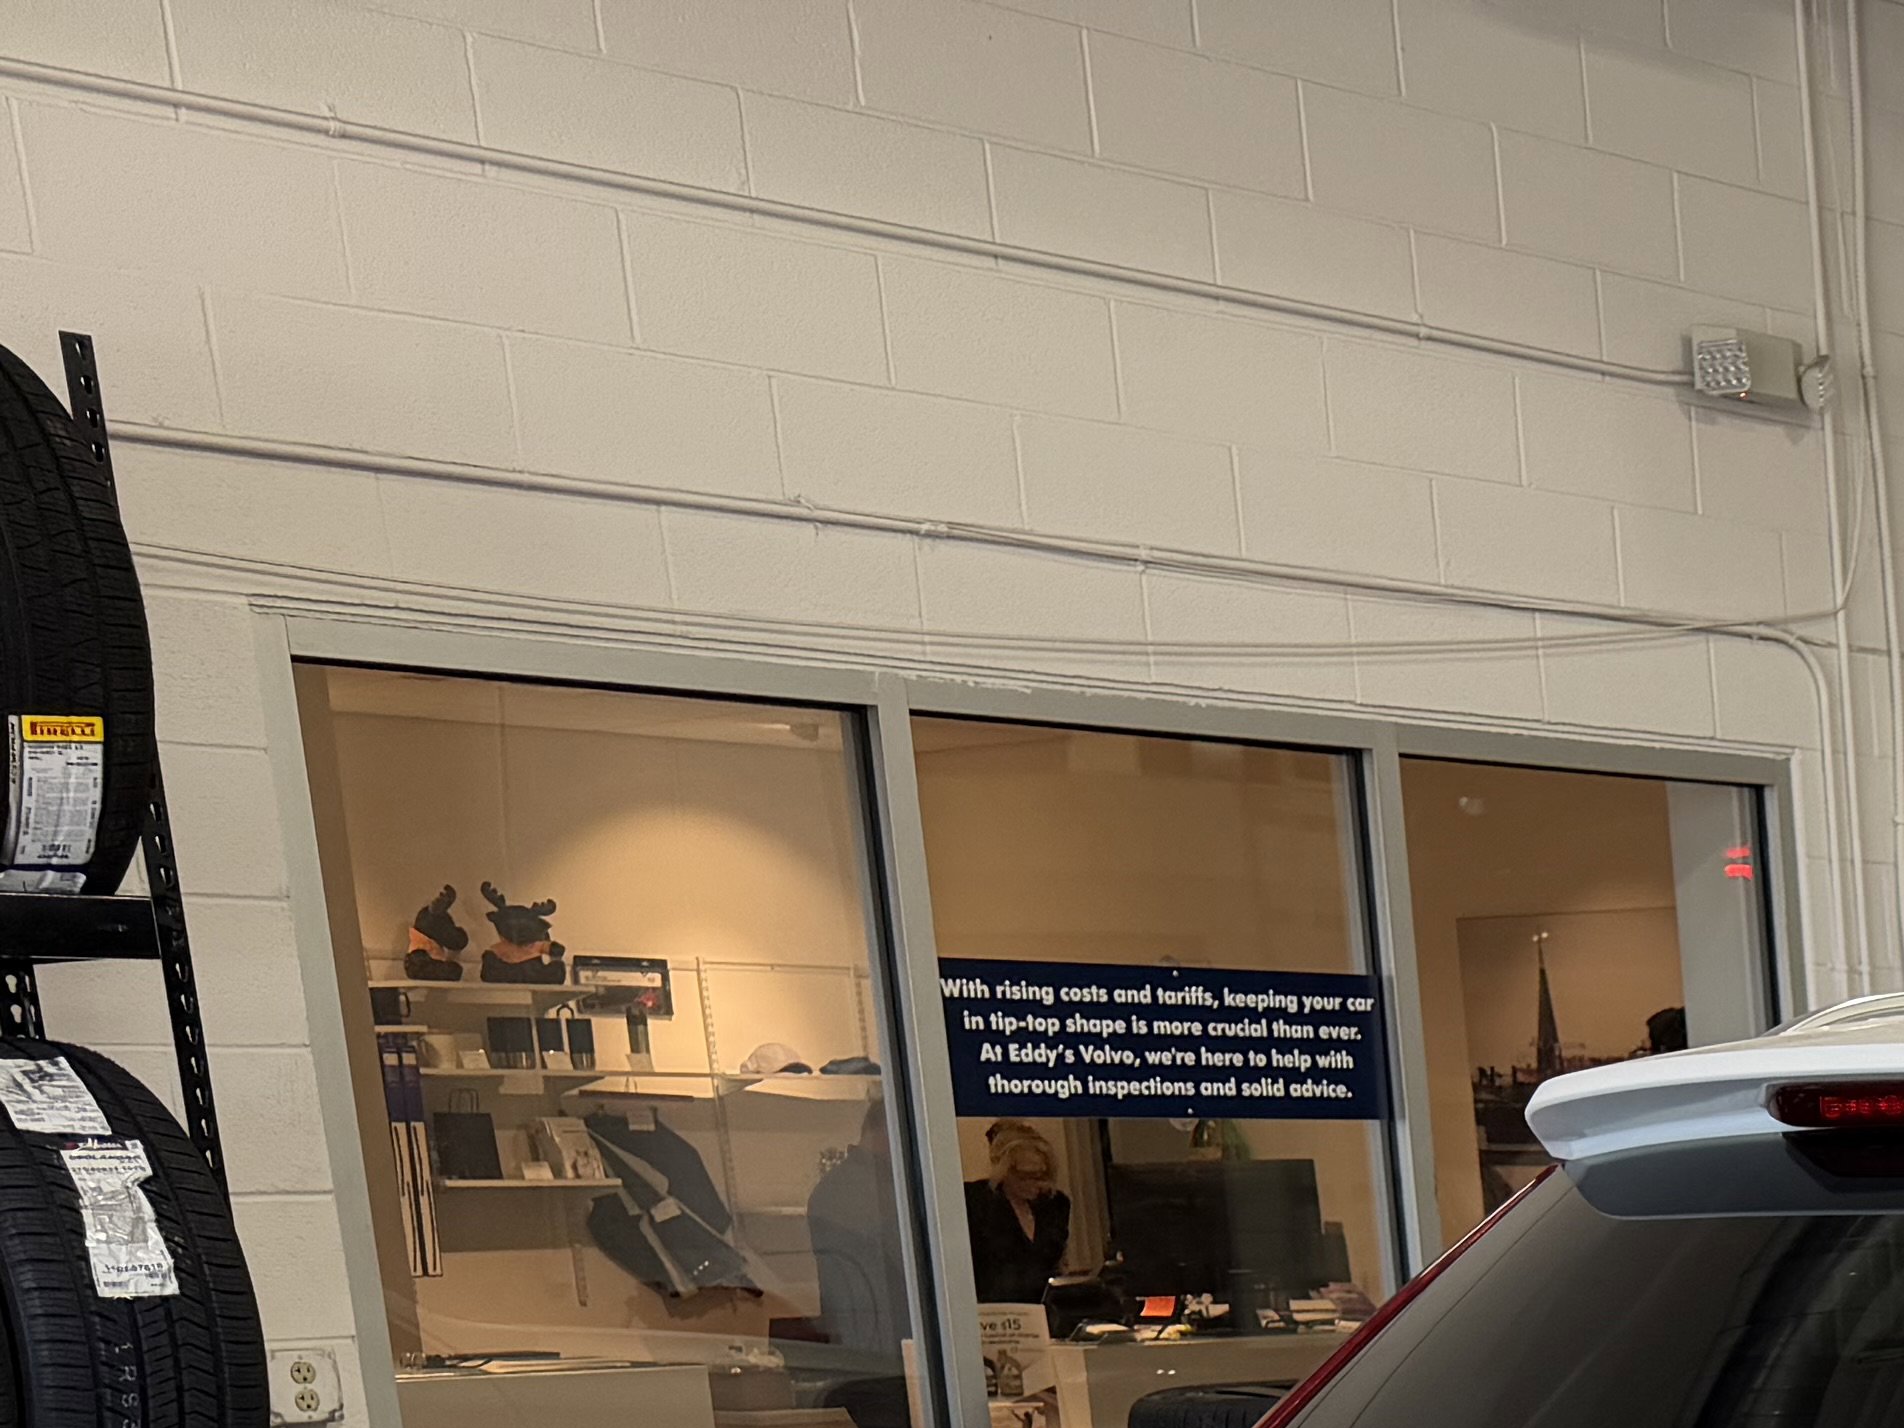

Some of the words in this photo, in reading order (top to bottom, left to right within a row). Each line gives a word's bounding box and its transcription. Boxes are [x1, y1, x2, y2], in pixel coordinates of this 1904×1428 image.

[29, 721, 96, 737] PIRELLI
[939, 978, 990, 998] With
[996, 980, 1054, 1005] rising
[1060, 985, 1108, 1003] costs
[1113, 984, 1152, 1004] and
[1157, 986, 1219, 1009] tariffs,
[1224, 987, 1298, 1013] keeping
[1302, 996, 1342, 1014] your
[1347, 997, 1375, 1011] car
[963, 1010, 985, 1030] in
[989, 1012, 1060, 1036] tip-top
[1066, 1013, 1126, 1038] shape
[1131, 1015, 1148, 1034] is
[1153, 1020, 1203, 1036] more
[1208, 1018, 1268, 1038] crucial
[1272, 1019, 1314, 1039] than
[1318, 1025, 1362, 1040] ever.
[980, 1043, 1002, 1062] At
[1008, 1043, 1075, 1067] Eddy's
[1079, 1044, 1141, 1067] Volvo,
[1145, 1047, 1196, 1065] we're
[1201, 1046, 1244, 1067] here
[1248, 1050, 1267, 1067] to
[1271, 1049, 1312, 1072] help
[1315, 1050, 1354, 1069] with
[988, 1074, 1083, 1099] thorough
[1088, 1075, 1195, 1100] inspections
[1200, 1077, 1236, 1096] and
[1242, 1078, 1285, 1097] solid
[1289, 1079, 1353, 1098] advice.
[980, 1320, 997, 1331] ve
